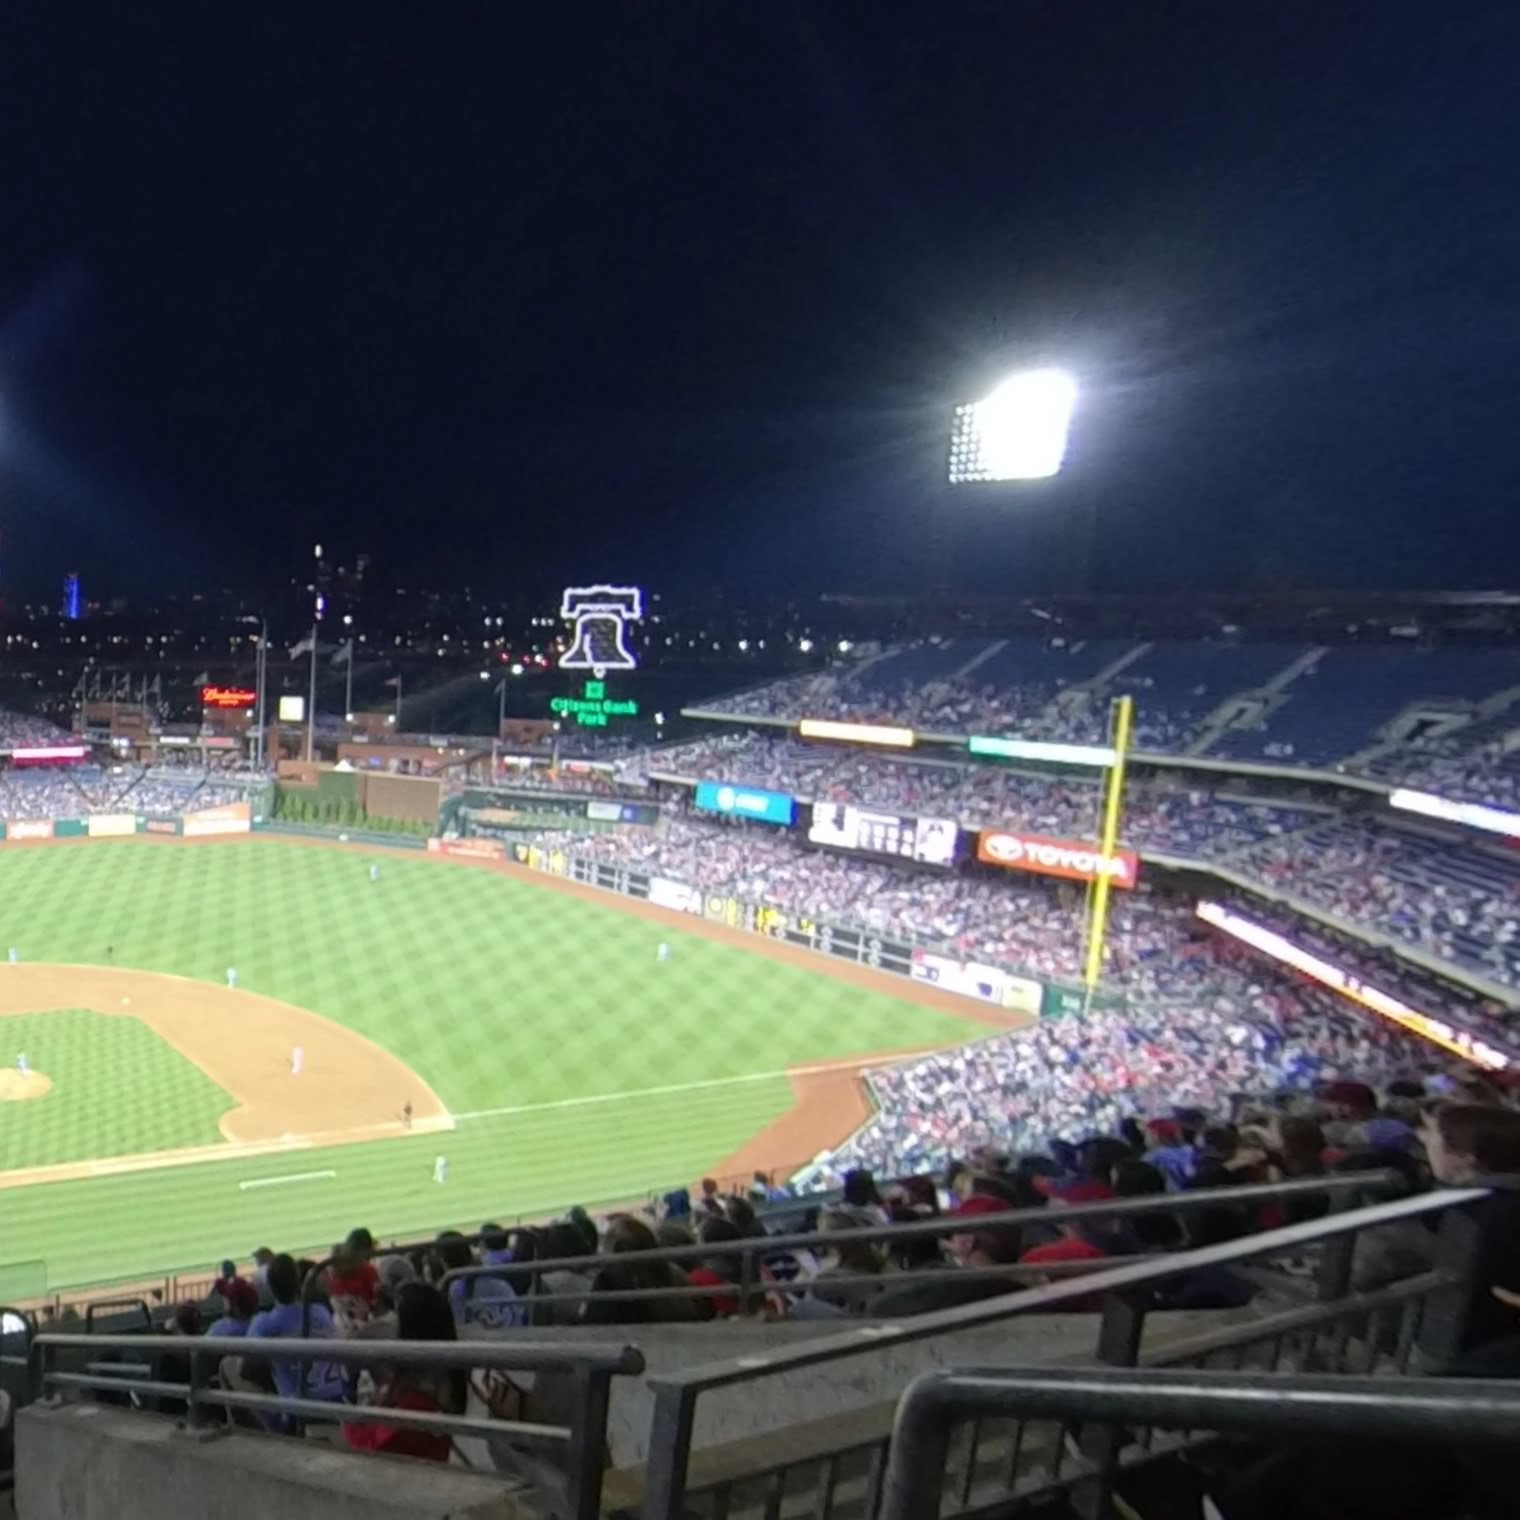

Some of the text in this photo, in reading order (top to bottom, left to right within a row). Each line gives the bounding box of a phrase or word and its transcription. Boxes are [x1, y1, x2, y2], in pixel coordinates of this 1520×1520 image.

[550, 697, 638, 715] Citizens Bank
[577, 712, 607, 726] Park
[1024, 842, 1127, 879] TOYOTA
